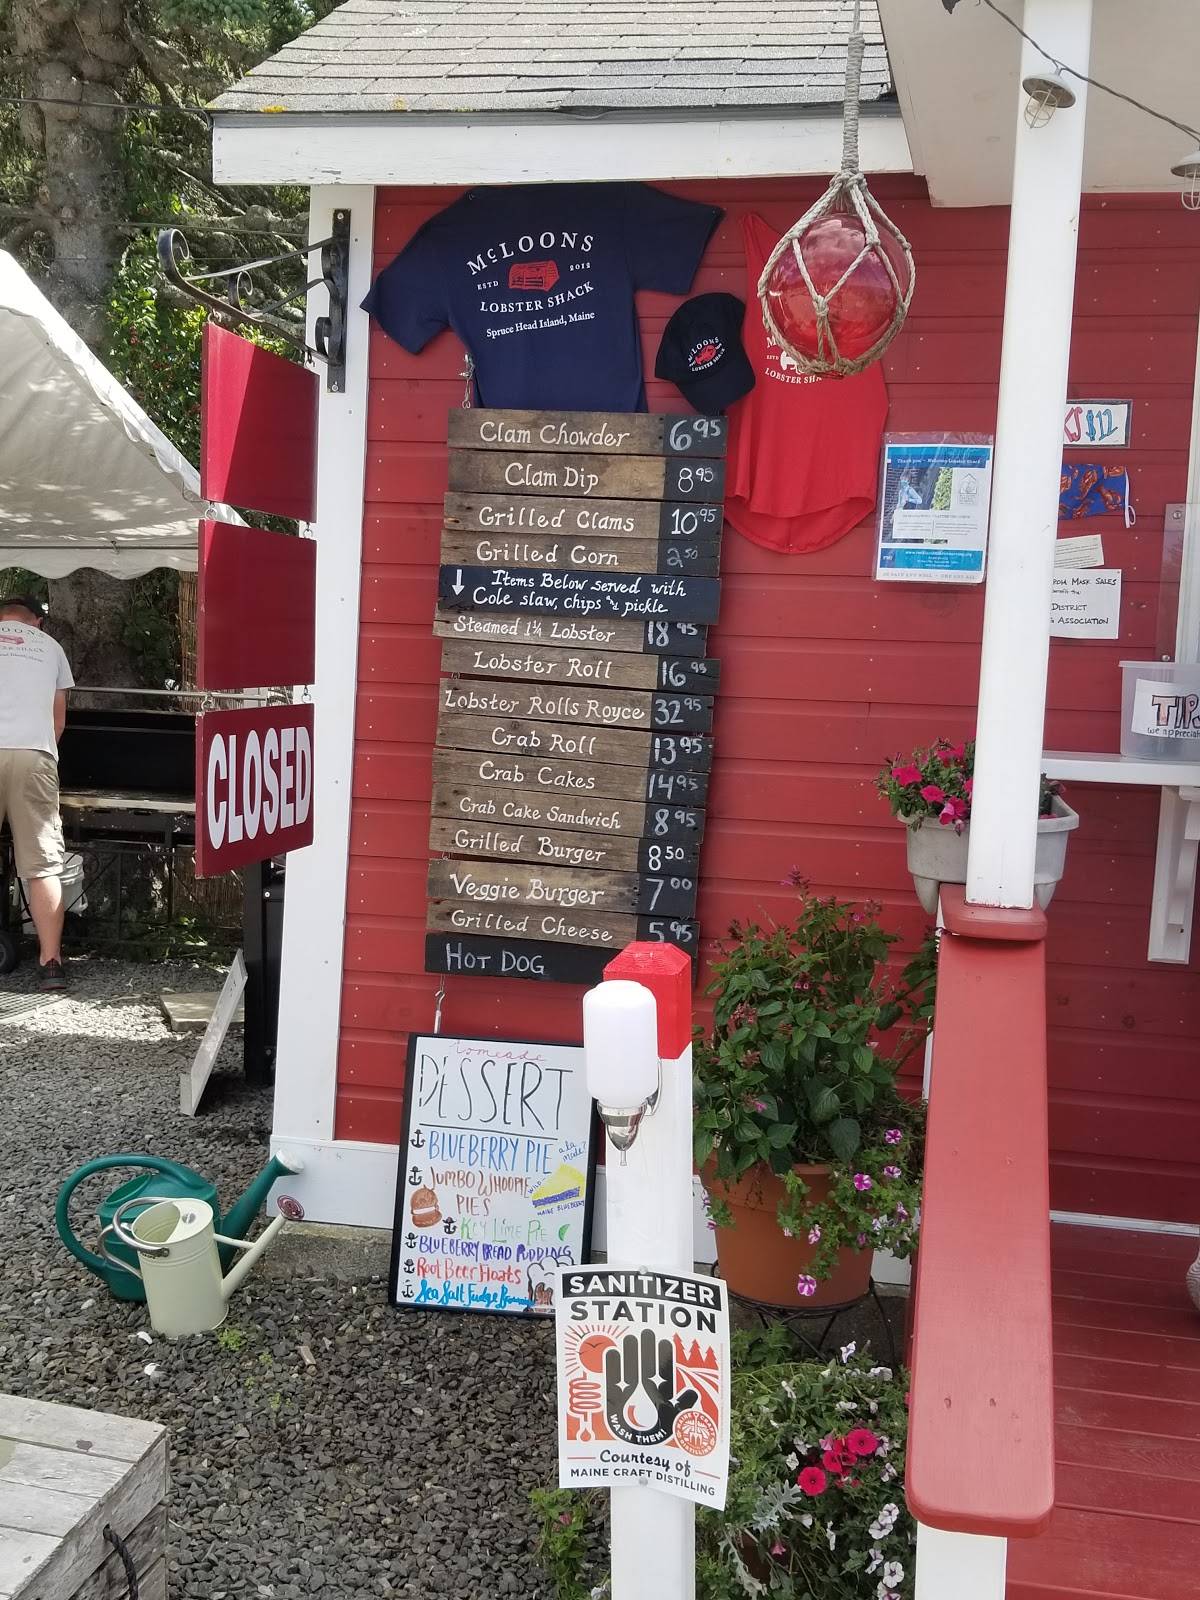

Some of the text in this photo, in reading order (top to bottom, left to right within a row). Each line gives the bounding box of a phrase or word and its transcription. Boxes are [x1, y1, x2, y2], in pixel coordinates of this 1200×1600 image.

[466, 231, 594, 275] McLOONS
[477, 262, 591, 290] ESTD 2012
[480, 281, 594, 313] LOBSTER SHACK
[486, 311, 595, 339] Spruce Head Island, Maine
[764, 367, 802, 384] LOBSTER
[479, 420, 531, 444] Clam
[539, 422, 630, 447] Chowder
[504, 462, 557, 487] Clam
[563, 467, 599, 494] Dip
[478, 506, 565, 528] Grilled
[576, 510, 635, 532] Clams
[476, 541, 557, 563] Grilled
[570, 545, 619, 566] Corn
[491, 569, 687, 597] Items Below served with
[473, 587, 513, 606] Cole
[519, 592, 558, 610] slaw,
[563, 596, 602, 616] chips
[621, 598, 669, 617] pickle
[453, 615, 518, 635] Steamed
[550, 624, 616, 643] Lobster
[1057, 616, 1109, 625] ASSOCIATION
[473, 651, 558, 674] Lobster
[566, 658, 612, 679] Roll
[444, 690, 520, 713] Lobster
[527, 696, 580, 717] Rolls
[585, 700, 646, 723] Royce
[491, 727, 541, 748] Crab
[549, 733, 597, 756] Roll
[207, 726, 312, 850] CLOSED
[478, 760, 525, 783] Crab
[537, 767, 595, 790] Cakes
[459, 797, 496, 815] Crab
[502, 802, 541, 820] Cake
[546, 806, 621, 830] Sandwich
[455, 829, 524, 853] Grilled
[538, 837, 606, 864] Burger
[450, 873, 520, 901] Veggie
[526, 878, 605, 907] Burger
[451, 909, 528, 932] Grilled
[541, 916, 613, 942] Cheese
[501, 950, 545, 974] DOG
[418, 1054, 574, 1130] DESSERT
[428, 1130, 553, 1175] BLUEBERRY PIE
[456, 1194, 491, 1216] PIES
[418, 1235, 480, 1262] BLUEBERRY
[416, 1257, 440, 1279] Root
[444, 1259, 477, 1282] Beer
[414, 1279, 439, 1303] Sea
[438, 1280, 465, 1305] Salt
[463, 1283, 498, 1307] Fudge
[569, 1275, 715, 1306] SANITIZER
[570, 1300, 716, 1334] STATION
[609, 1413, 667, 1444] WASH THEM!
[599, 1449, 692, 1478] Courtesy of
[570, 1468, 716, 1496] MAINE CRAFT DISTILLING
